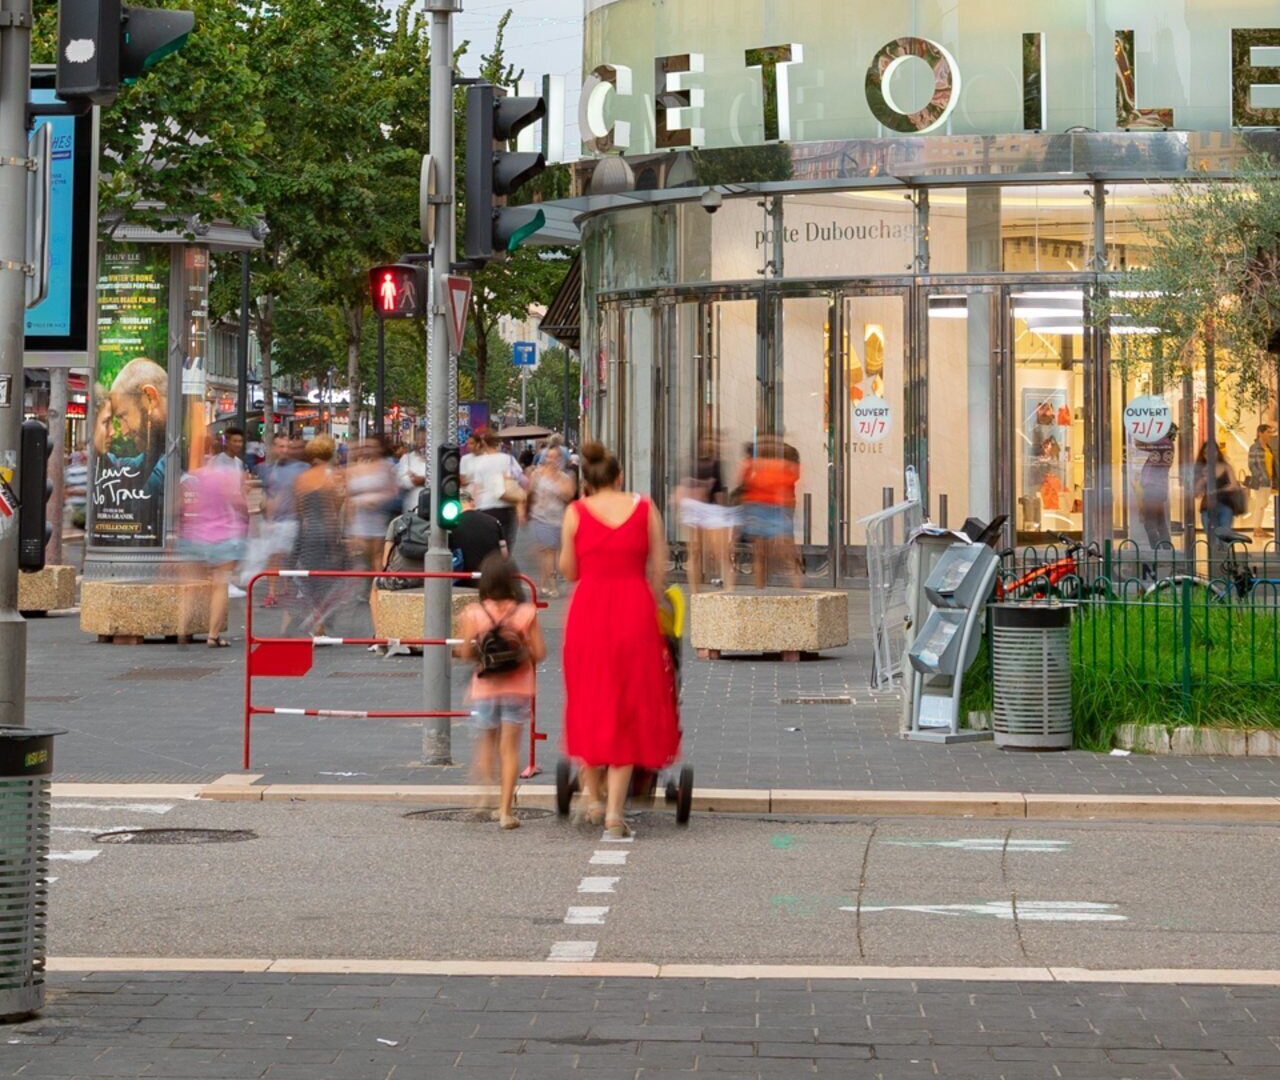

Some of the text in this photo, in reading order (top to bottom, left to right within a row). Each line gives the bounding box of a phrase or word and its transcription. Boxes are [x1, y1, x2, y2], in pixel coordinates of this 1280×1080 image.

[854, 407, 889, 417] OUVERT
[1126, 407, 1168, 417] OUVERT
[1131, 417, 1165, 438] 7J/7
[95, 456, 140, 485] Leave
[102, 479, 151, 506] Trace
